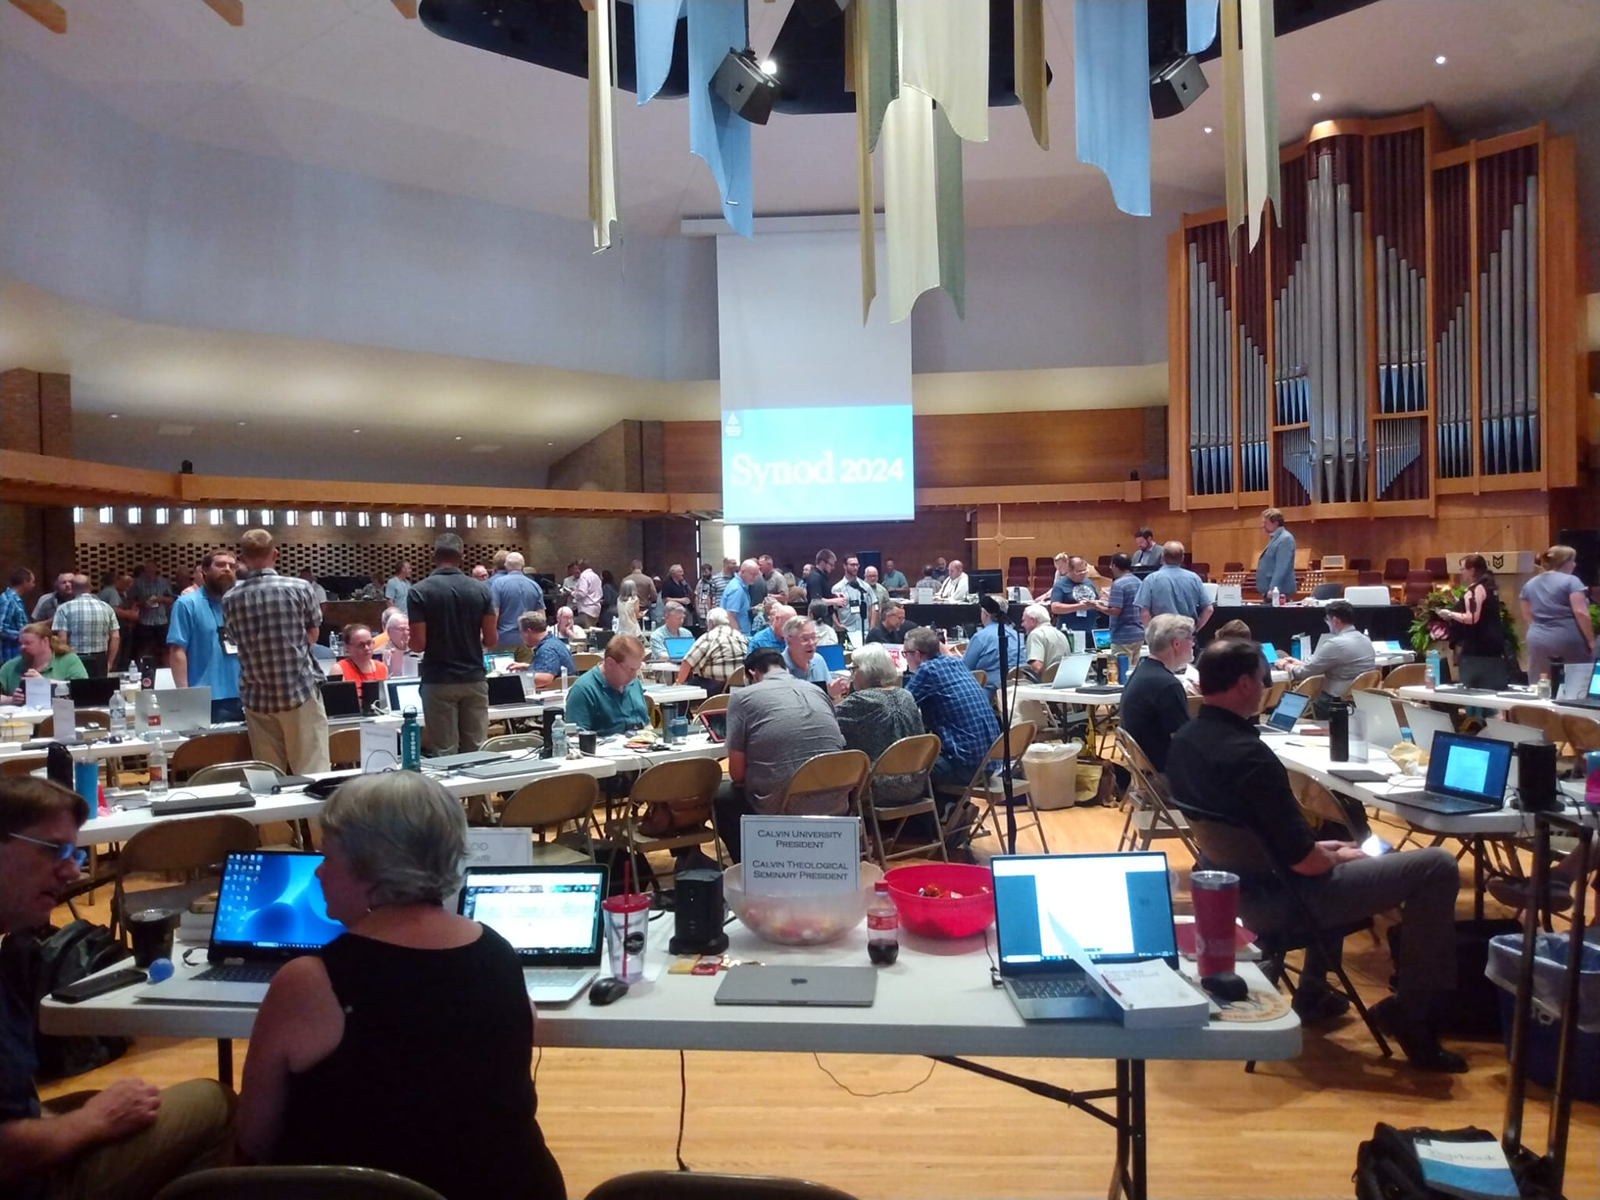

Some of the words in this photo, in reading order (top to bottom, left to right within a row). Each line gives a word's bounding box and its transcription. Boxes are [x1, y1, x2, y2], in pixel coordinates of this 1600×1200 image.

[730, 450, 835, 493] Synod
[841, 458, 904, 483] 2024
[757, 829, 790, 838] CALVIN
[792, 830, 842, 839] UNIVERSITY
[752, 860, 785, 868] CALVIN
[788, 860, 849, 870] THEOLOGICAL
[753, 871, 797, 879] SEMINARY
[799, 872, 849, 880] PRESIDENT
